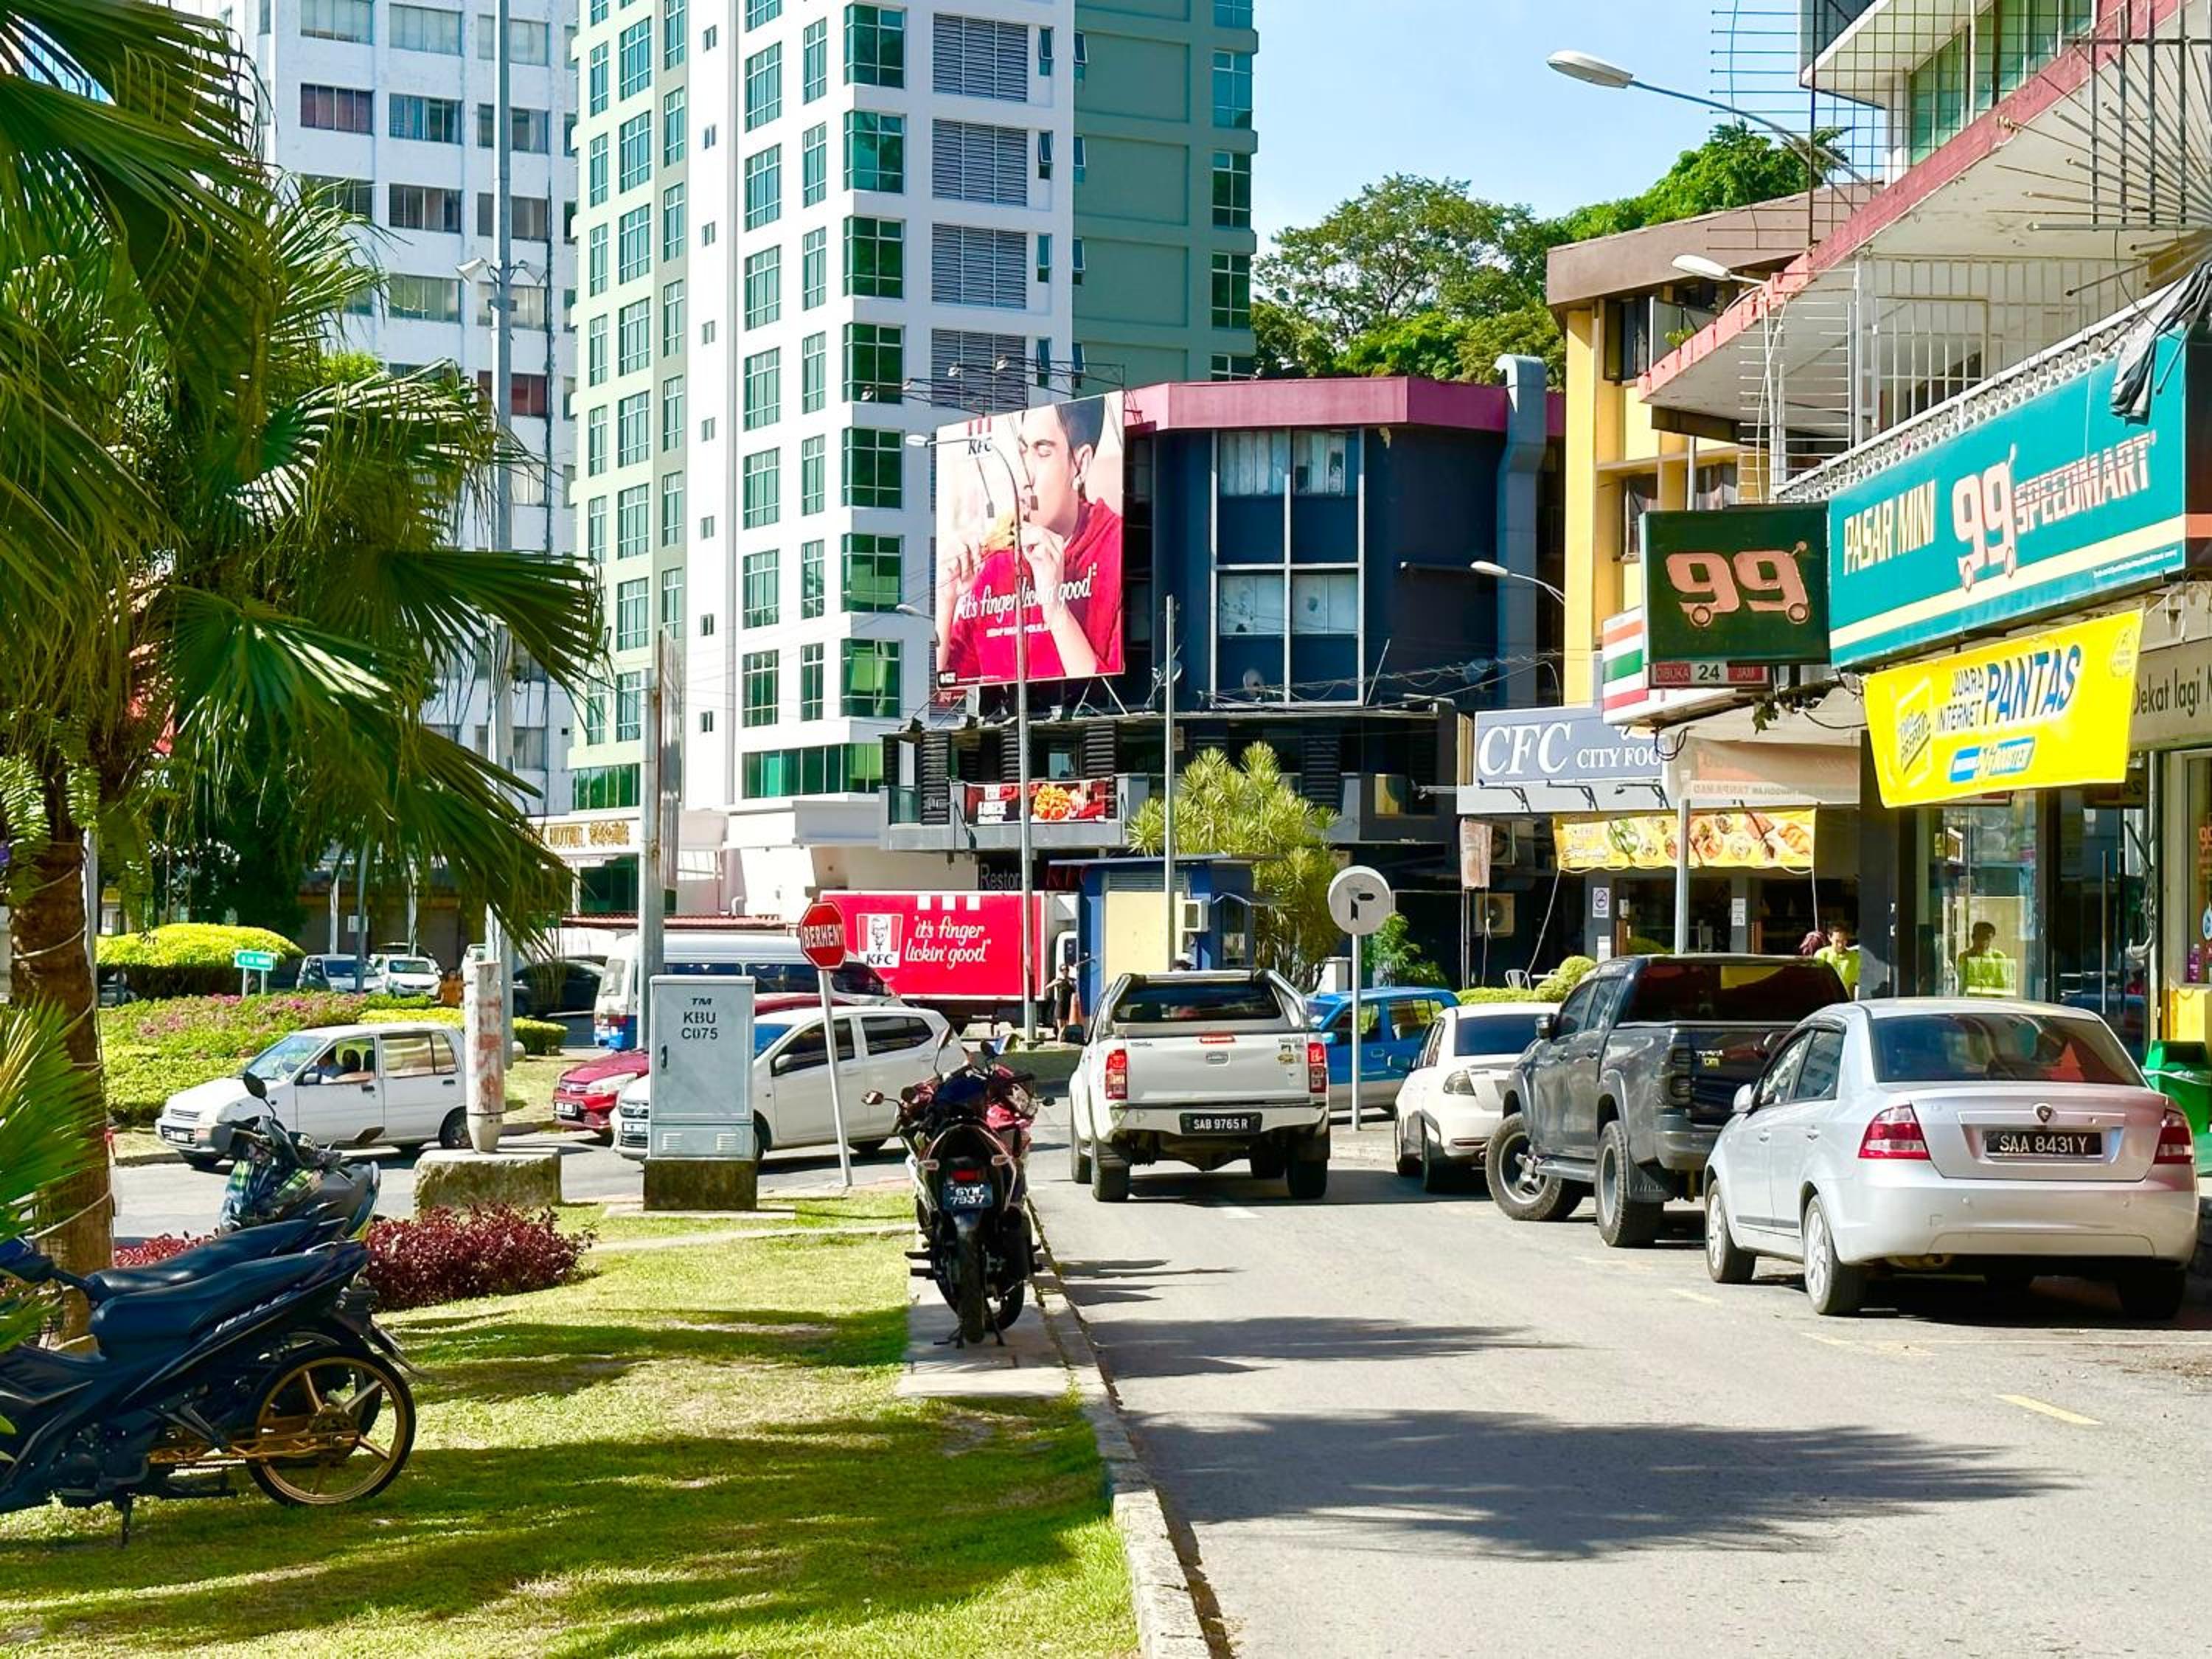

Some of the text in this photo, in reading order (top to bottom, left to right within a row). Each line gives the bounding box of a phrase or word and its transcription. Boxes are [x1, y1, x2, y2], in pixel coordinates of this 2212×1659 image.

[1843, 479, 1935, 575] PASAR MINI
[1951, 435, 2151, 593] 99 SPEEDMART
[1666, 540, 1810, 627] 99
[980, 585, 1018, 624] finger
[1698, 664, 1719, 681] 24
[1951, 667, 1983, 697] JUARA
[1983, 644, 2081, 726] PANTAS
[2174, 667, 2199, 718] lagi
[1935, 700, 1982, 732] INTERNET
[1479, 722, 1571, 776] CFC
[1576, 748, 1621, 768] CITY
[980, 863, 1023, 890] Restor
[939, 915, 985, 947] finger
[866, 953, 893, 965] KFC
[691, 998, 712, 1006] TM
[684, 1012, 716, 1024] KBU
[681, 1028, 718, 1040] C075
[1193, 1119, 1211, 1130] SAB
[1241, 1119, 1248, 1129] R
[1999, 1134, 2088, 1153] SAA 8431 Y
